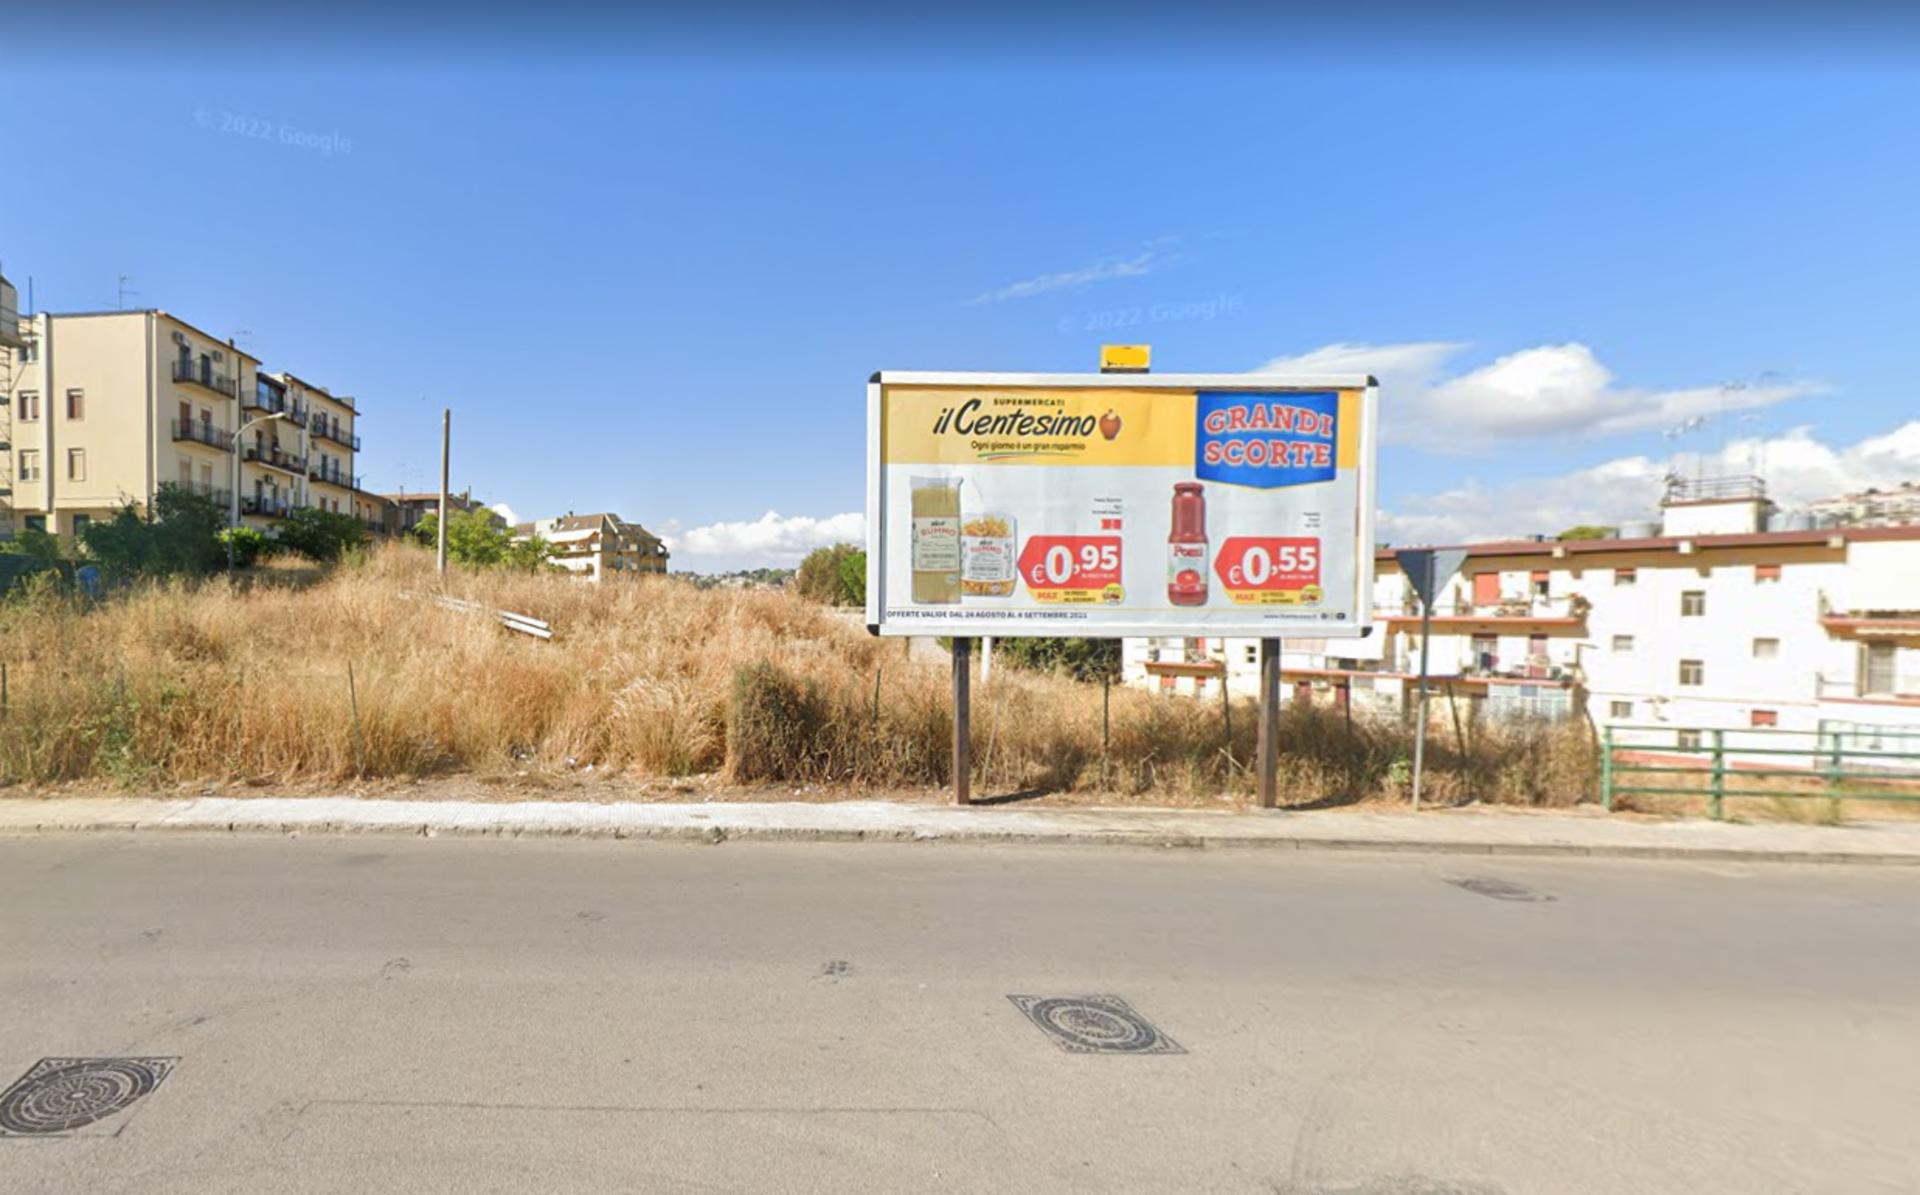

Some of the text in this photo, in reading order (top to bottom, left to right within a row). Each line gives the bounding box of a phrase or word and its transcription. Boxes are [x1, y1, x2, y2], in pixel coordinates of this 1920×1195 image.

[993, 398, 1065, 406] SUPERMERCATI
[933, 398, 1096, 437] il Centesimo
[1204, 403, 1333, 438] GRANDI
[971, 440, 988, 451] Ogni
[990, 441, 1015, 451] giorno
[1033, 443, 1050, 452] gran
[1051, 441, 1086, 452] risparmio
[1204, 440, 1331, 466] SCORTE
[975, 611, 1006, 619] AGOSTO
